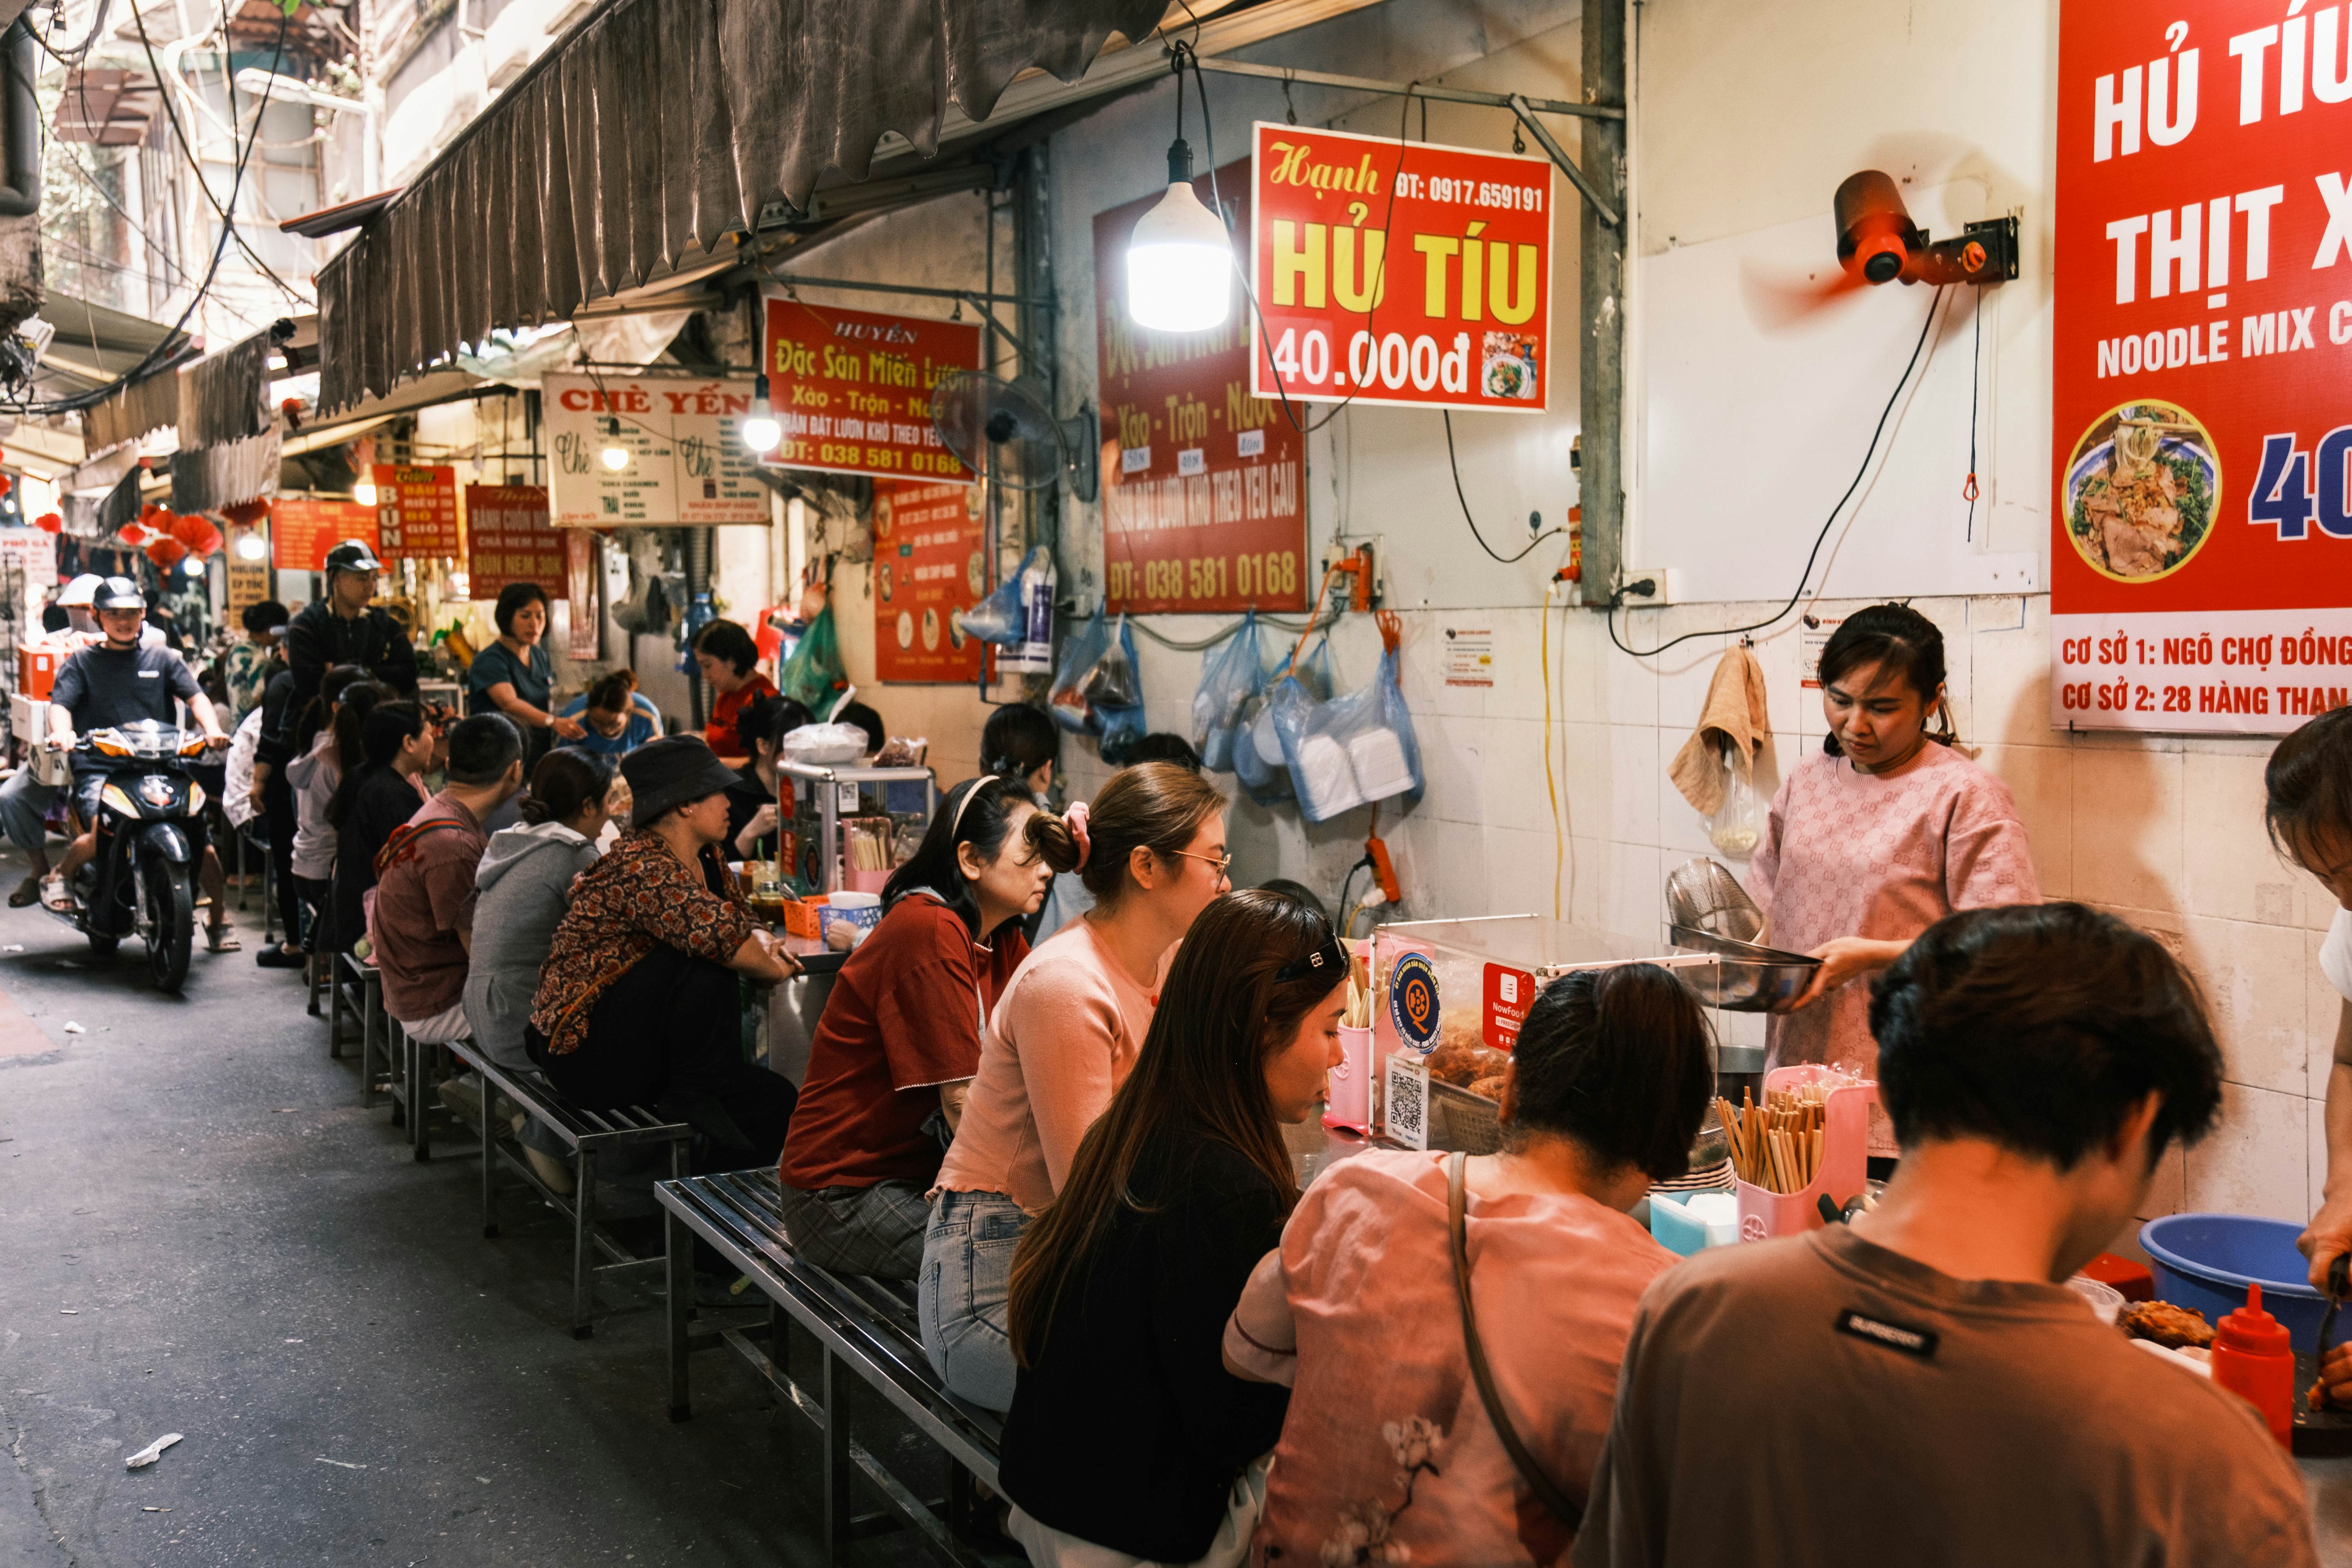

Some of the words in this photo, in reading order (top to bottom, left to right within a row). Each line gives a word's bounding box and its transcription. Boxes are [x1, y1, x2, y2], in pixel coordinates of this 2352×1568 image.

[2094, 20, 2199, 163] HỦ
[1269, 142, 1380, 199] Hạnh
[1396, 173, 1424, 200] ĐT:
[1430, 177, 1542, 212] 0917.659191
[1272, 201, 1388, 314] HỦ
[1414, 220, 1538, 325] TÍU
[2106, 184, 2284, 309] THỊT
[776, 338, 816, 380] Đặc
[823, 344, 860, 382] Sản
[1269, 328, 1471, 393] 40.000đ
[2097, 320, 2228, 379] NOODLE
[2242, 306, 2315, 358] MIX
[560, 384, 651, 413] CHÈ
[663, 383, 752, 415] YẾN
[792, 385, 828, 408] Xào
[847, 390, 889, 417] Trộn
[1166, 392, 1207, 450] Trộn
[781, 440, 814, 461] ĐT:
[820, 444, 860, 464] 038
[867, 448, 902, 469] 581
[911, 452, 962, 474] 0168
[893, 424, 920, 445] THEO
[1213, 468, 1242, 523] THEO
[1110, 561, 1140, 600] ĐT:
[1145, 559, 1183, 599] 038
[1190, 556, 1227, 599] 581
[1237, 551, 1296, 596] 0168
[2062, 636, 2092, 664] CƠ
[2099, 629, 2128, 664] SỞ
[2136, 638, 2155, 664] 1:
[2163, 632, 2212, 665] NGÕ
[2222, 635, 2273, 671] CHỢ
[2280, 627, 2352, 665] ĐỒNG
[2062, 682, 2092, 709] CƠ
[2098, 676, 2128, 711] SỞ
[2135, 686, 2155, 712] 2:
[2163, 686, 2191, 712] 28
[2200, 681, 2268, 715] HÀNG
[2277, 687, 2348, 715] THAN
[1493, 1001, 1524, 1019] NowFood
